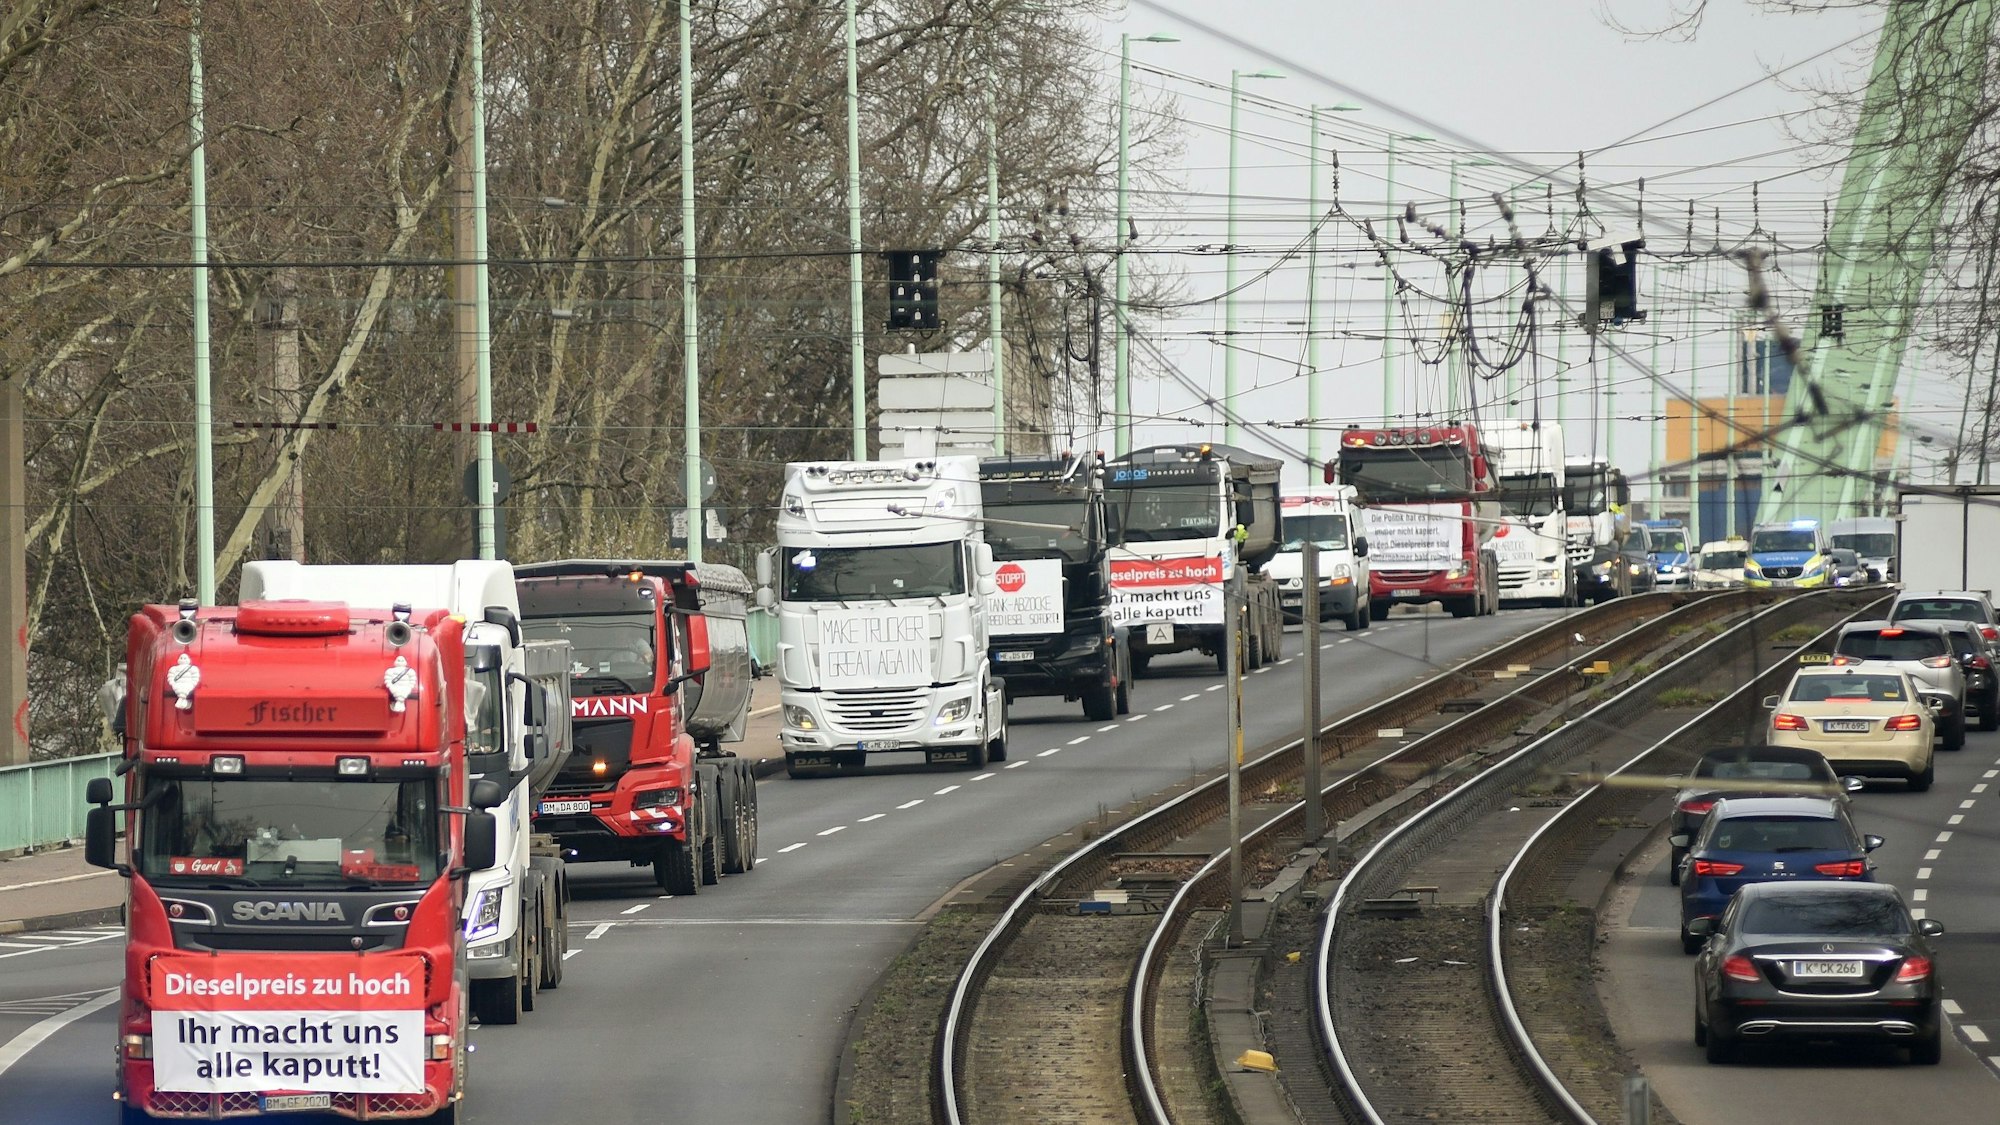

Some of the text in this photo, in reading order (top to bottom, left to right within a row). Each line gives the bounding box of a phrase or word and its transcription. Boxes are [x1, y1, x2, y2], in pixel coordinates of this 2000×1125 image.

[1148, 468, 1194, 476] transport
[1384, 514, 1404, 522] Politik
[1406, 513, 1416, 522] hat
[1398, 528, 1413, 536] nicht
[1390, 540, 1434, 549] Dieselpreisen
[1436, 540, 1450, 548] sind
[996, 573, 1024, 585] STOPPT
[1111, 568, 1166, 582] eselpreis
[1186, 565, 1216, 577] hoch
[1130, 590, 1179, 602] macht
[1184, 590, 1211, 600] uns
[1114, 604, 1203, 620] alle kaputt!
[823, 616, 924, 644] MAKE TRUCKER
[1154, 627, 1168, 640] A
[828, 648, 923, 677] GREAT AGAIN
[246, 700, 338, 726] Fischer
[191, 858, 221, 874] Gerd
[232, 901, 346, 921] SCANIA
[1836, 963, 1857, 974] 266
[166, 972, 410, 1000] Dieselpreis zu hoch
[178, 1018, 399, 1044] Ihr macht uns
[196, 1052, 380, 1084] alle kaputt!
[303, 1096, 328, 1108] 2020
